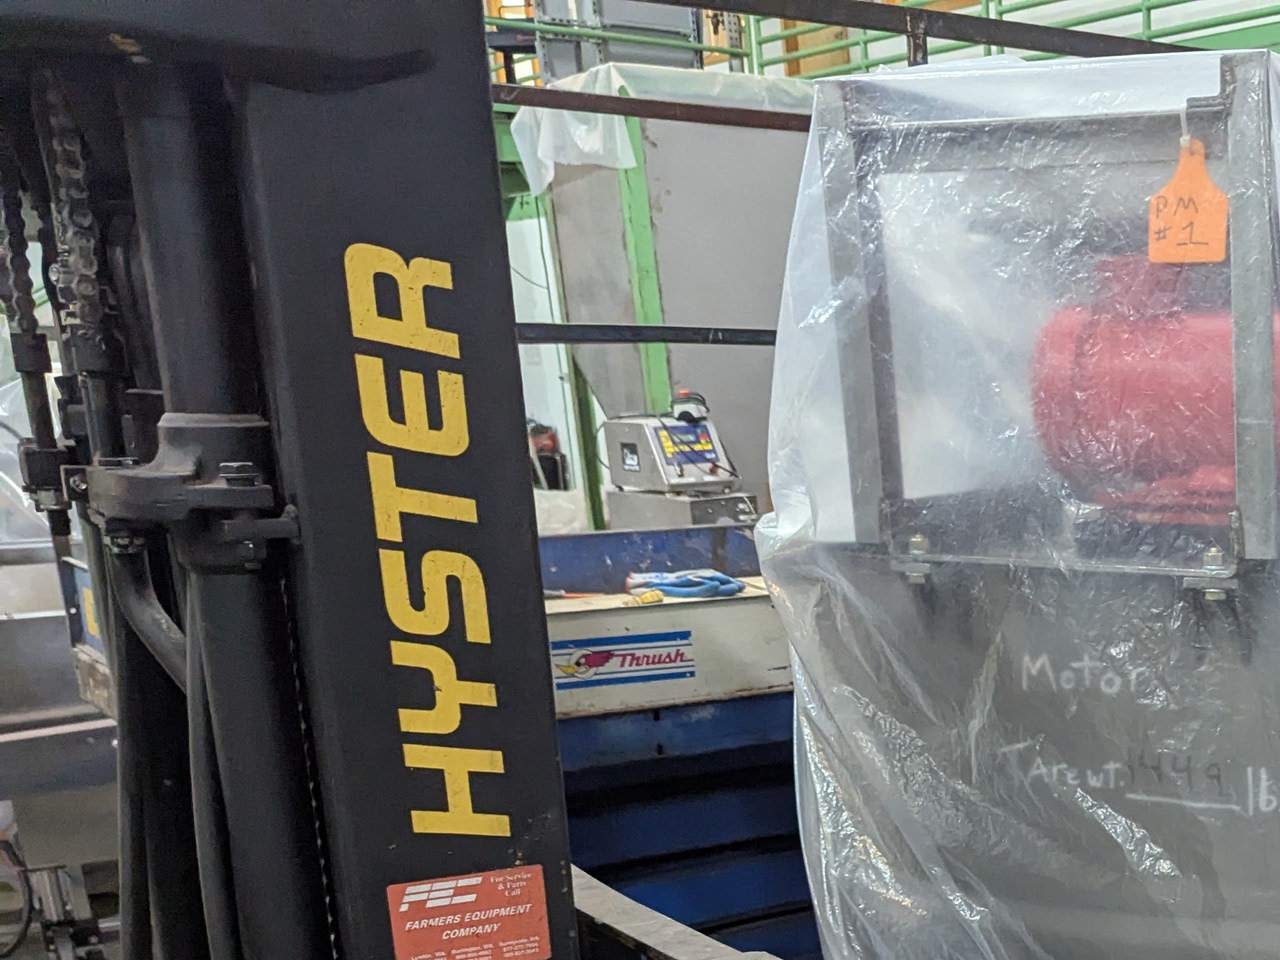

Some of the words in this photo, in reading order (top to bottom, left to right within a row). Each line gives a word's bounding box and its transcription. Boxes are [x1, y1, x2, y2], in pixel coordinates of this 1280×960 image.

[344, 242, 511, 838] HYSTER
[615, 649, 694, 668] Thrush
[1021, 653, 1149, 694] Motor
[399, 877, 483, 912] FEC
[405, 914, 462, 931] FARMERS
[464, 904, 533, 922] EQUIPMENT
[442, 923, 501, 940] COMPANY
